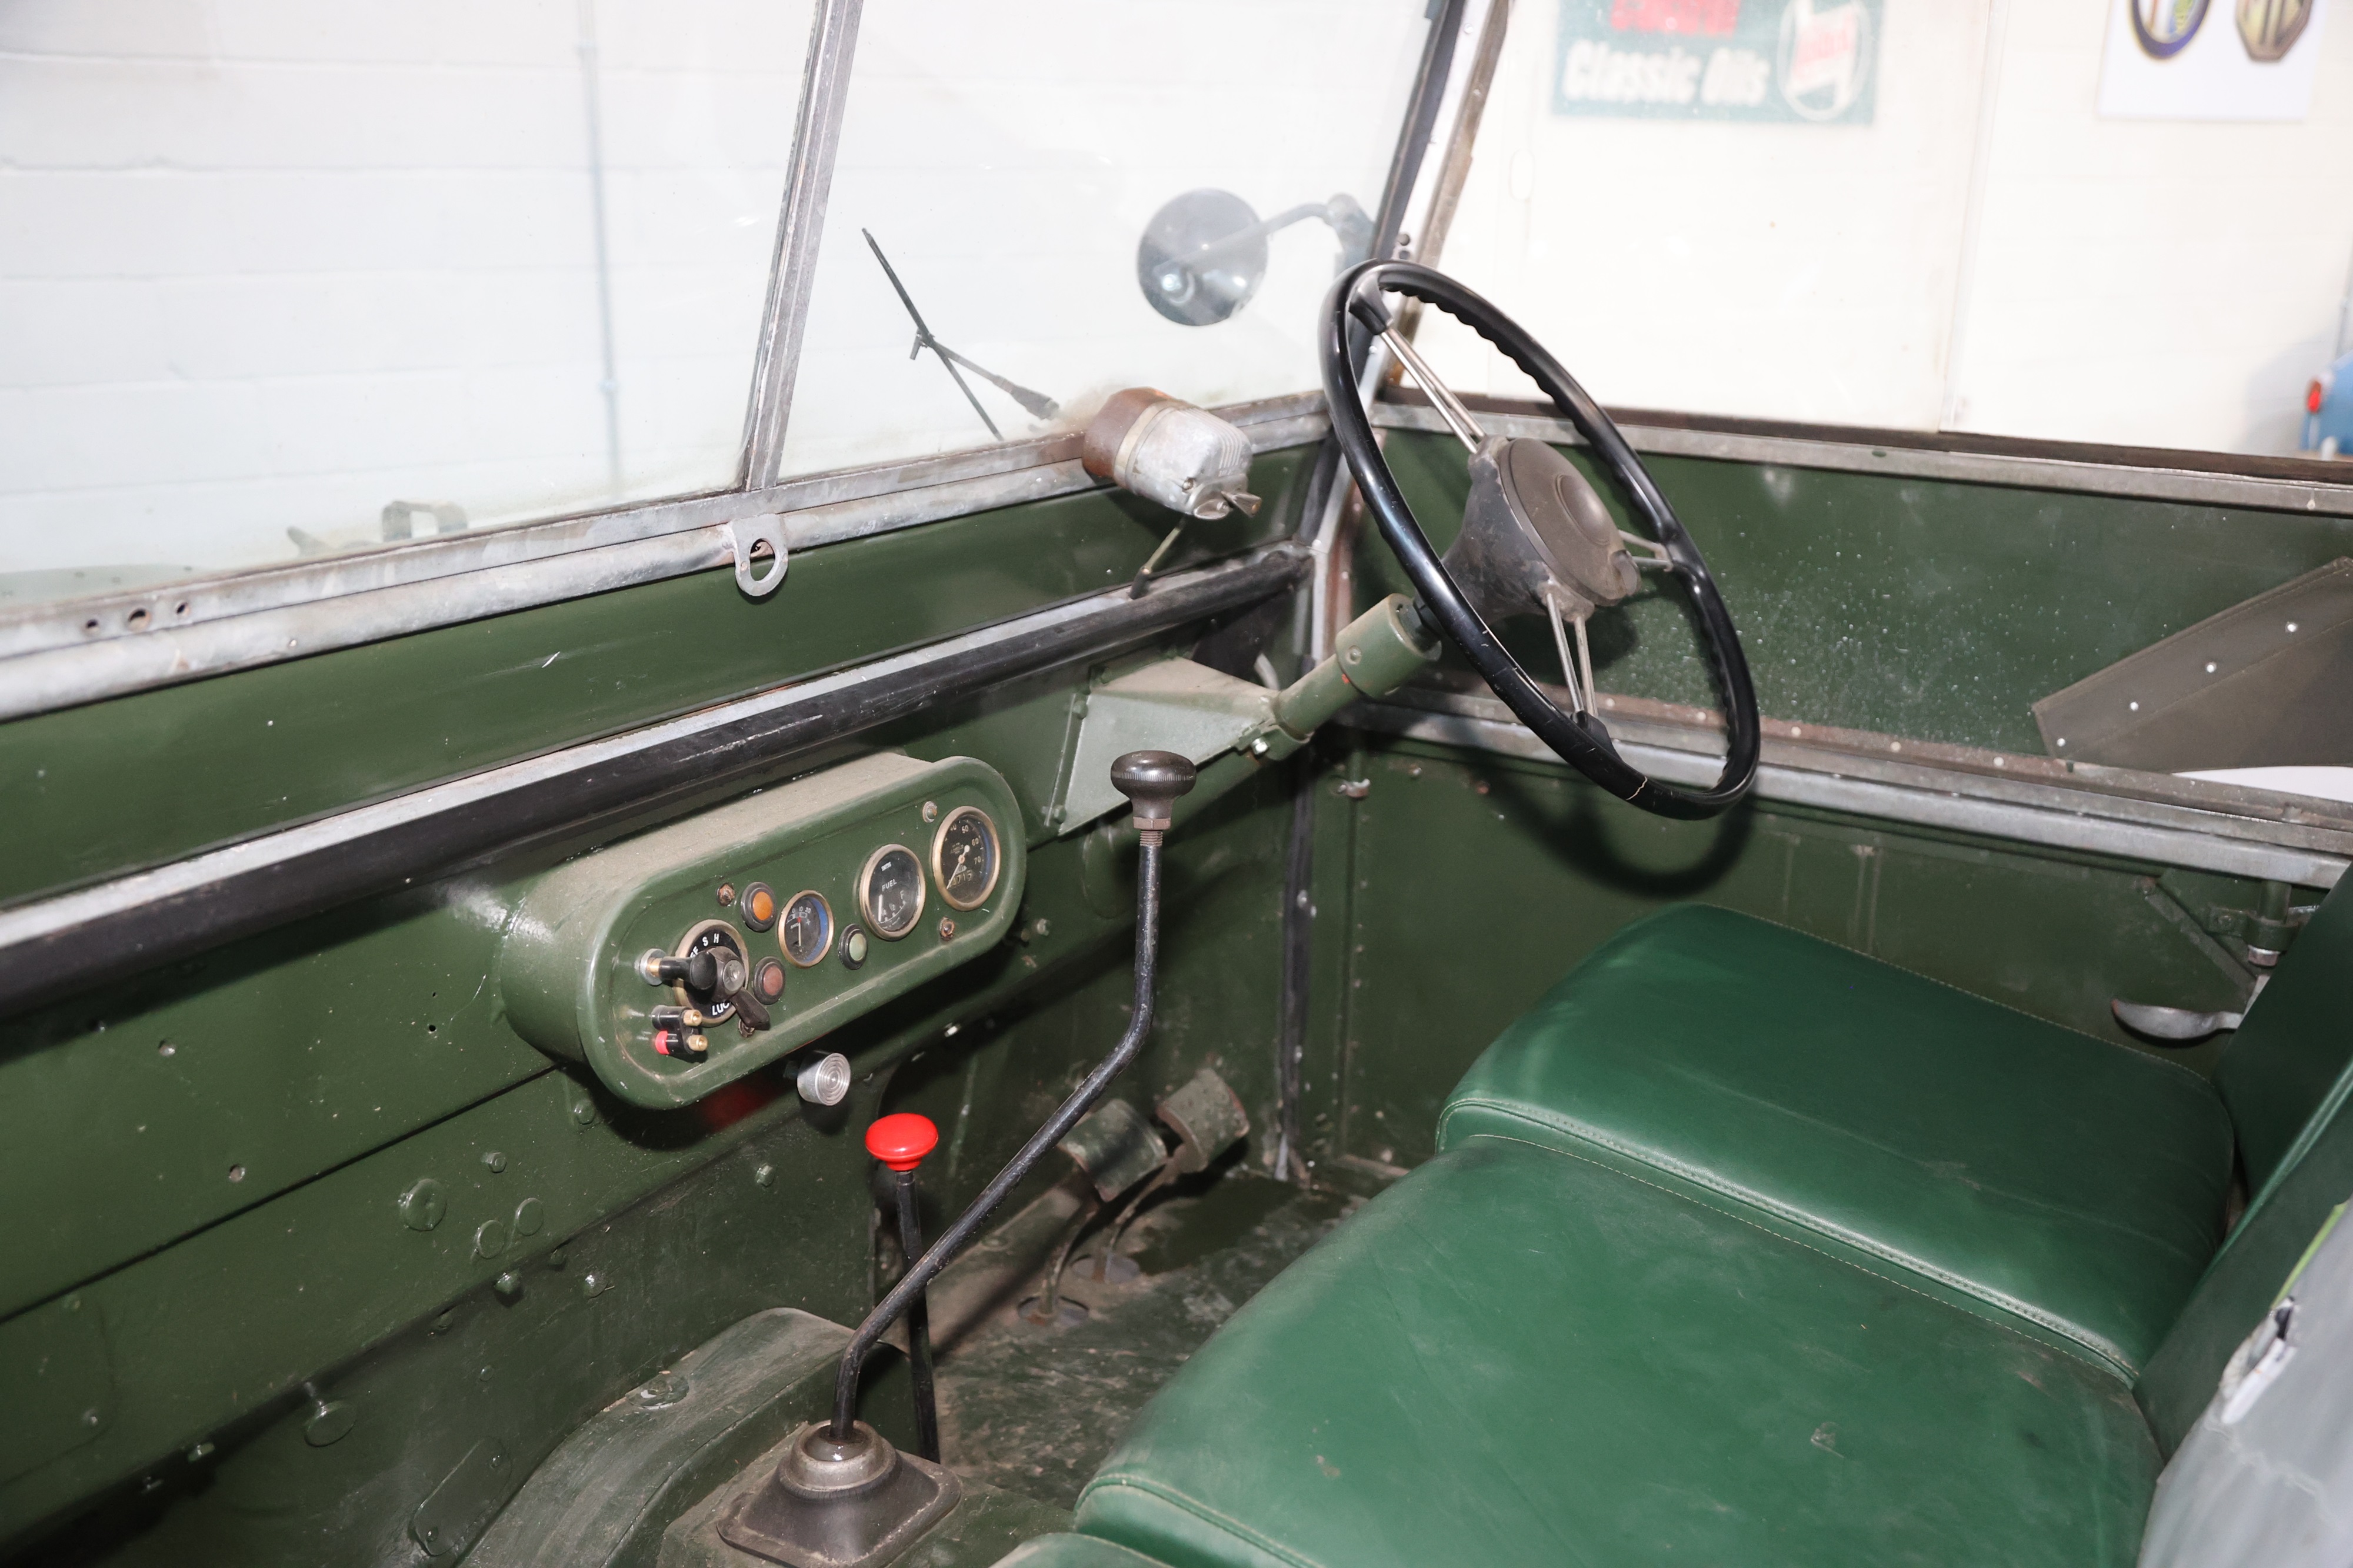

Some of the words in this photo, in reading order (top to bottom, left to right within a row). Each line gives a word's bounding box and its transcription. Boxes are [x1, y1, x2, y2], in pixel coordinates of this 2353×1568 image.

[1564, 38, 1699, 104] Classic
[1701, 47, 1770, 106] Oils
[962, 825, 969, 833] 50
[972, 838, 979, 846] 60
[974, 856, 981, 865] 70
[882, 879, 897, 892] FUEL
[702, 936, 708, 946] S
[714, 933, 719, 943] H
